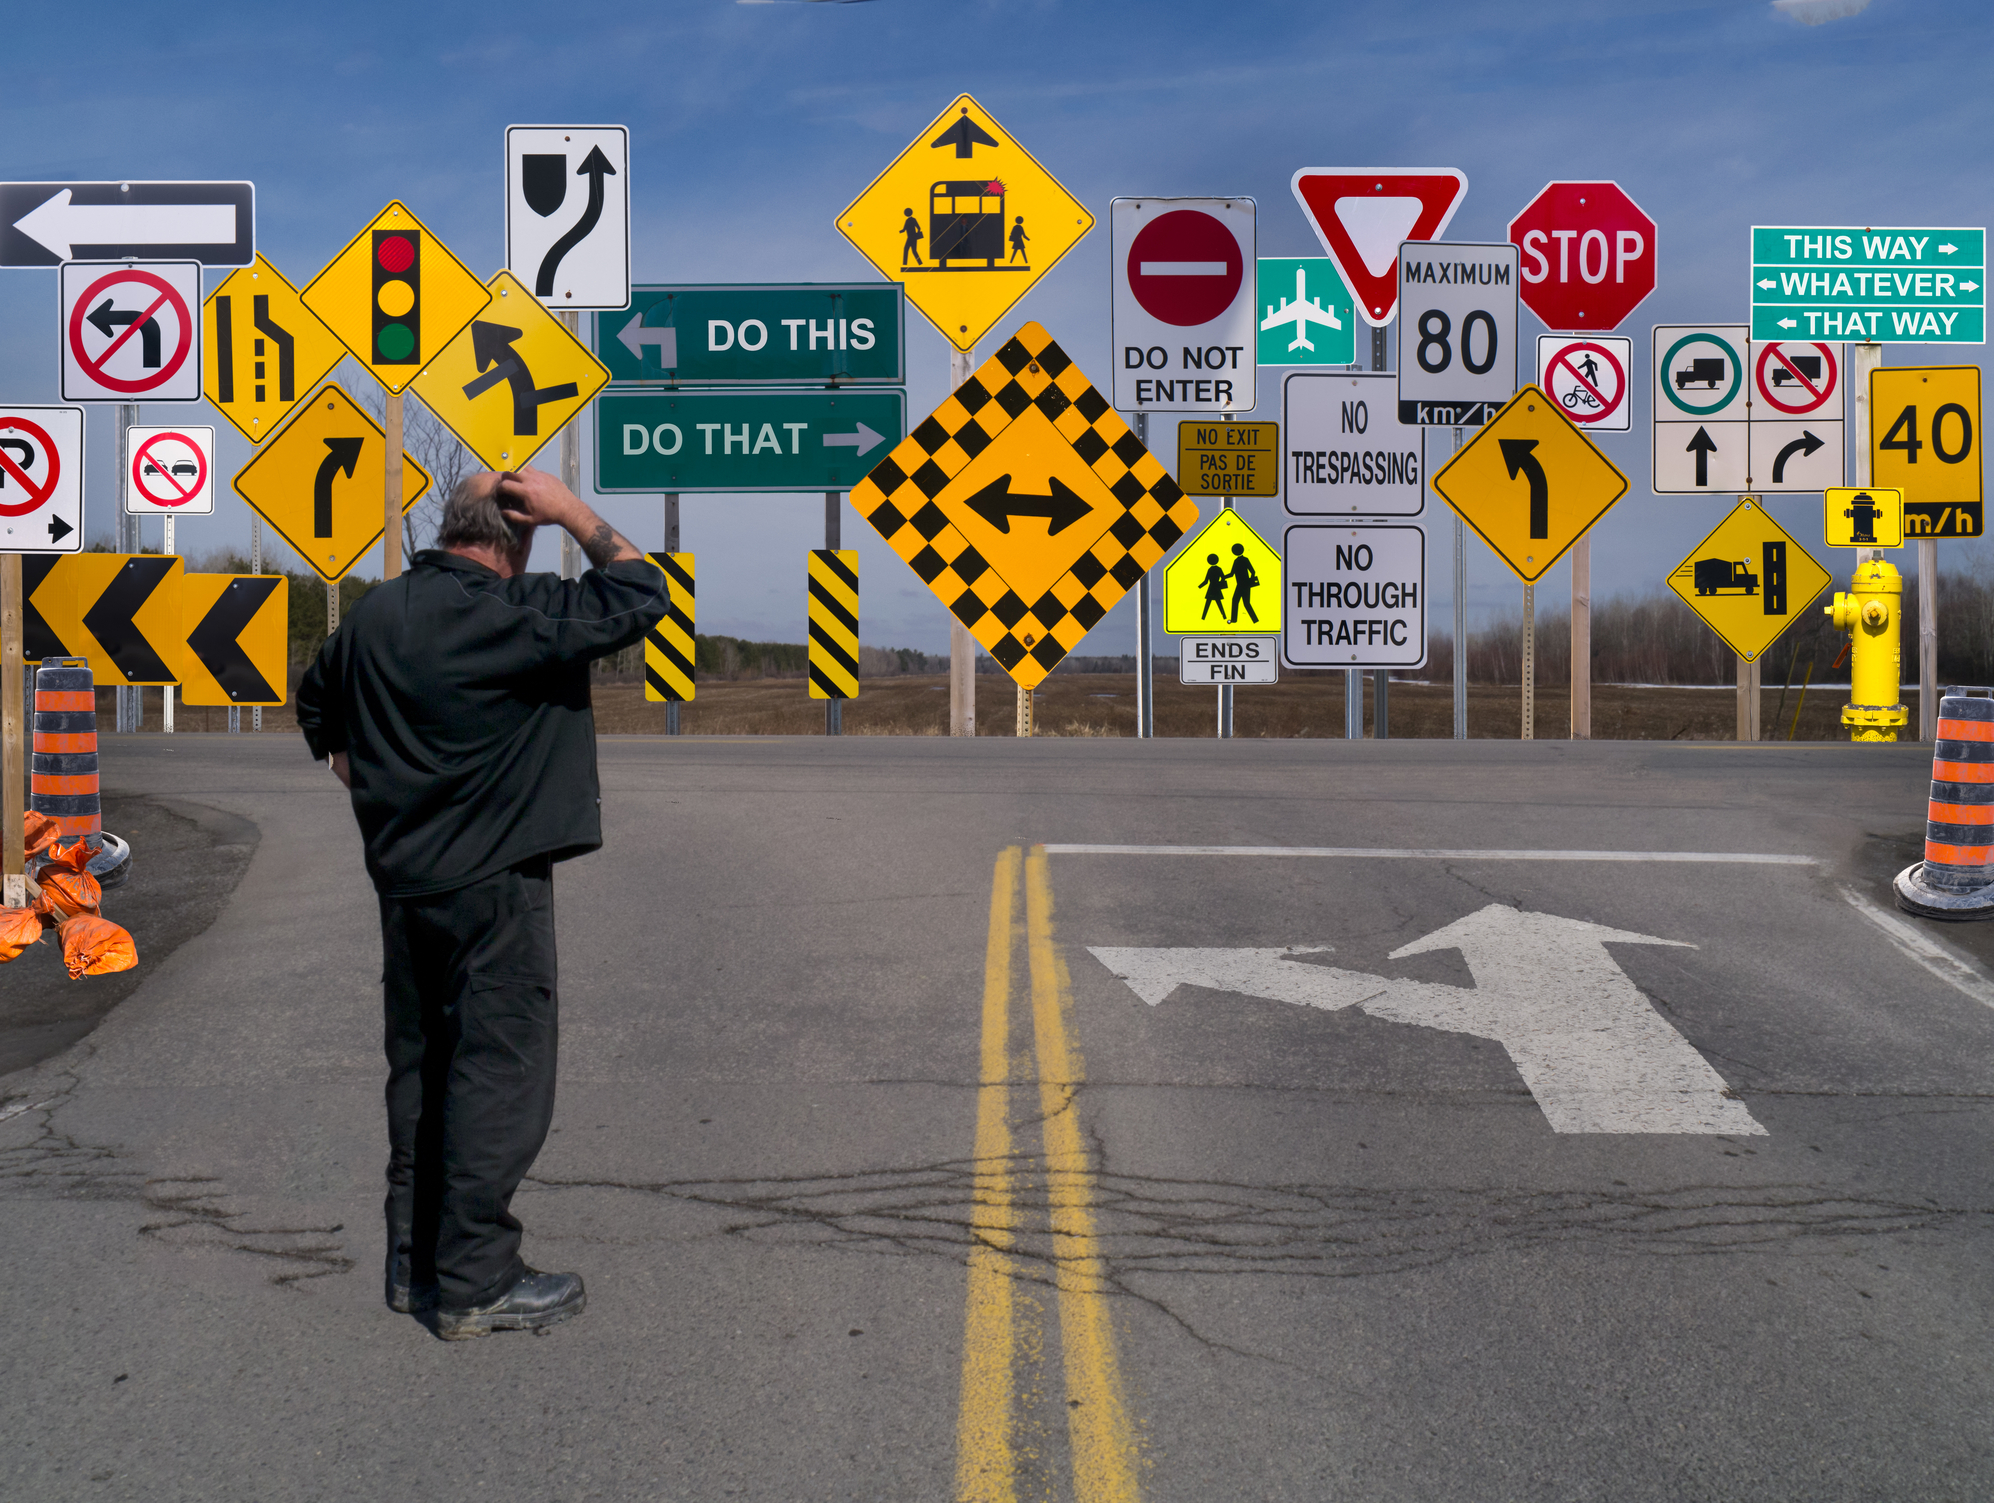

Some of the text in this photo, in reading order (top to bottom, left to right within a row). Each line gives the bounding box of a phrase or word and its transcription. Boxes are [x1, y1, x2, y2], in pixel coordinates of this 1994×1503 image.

[1521, 229, 1644, 284] STOP
[1784, 235, 1930, 260] THIS WAY
[1406, 261, 1510, 286] MAXIMUM
[1780, 272, 1956, 297] WHATEVER
[708, 318, 876, 352] DO THIS
[1803, 311, 1959, 336] THAT WAY
[1416, 308, 1498, 375] 80
[1124, 346, 1244, 370] DO NOT
[1136, 379, 1233, 402] ENTER
[1341, 400, 1369, 435] NO
[1416, 402, 1498, 425] km/h
[623, 423, 808, 456] DO THAT
[1197, 428, 1260, 446] NO EXIT
[1879, 402, 1972, 464] 40
[1200, 454, 1256, 471] PAS DE
[1292, 451, 1418, 485] TRESPASSING
[1201, 474, 1255, 490] SORTIE
[1905, 507, 1973, 534] m/h
[1335, 544, 1373, 571] NO
[1292, 581, 1418, 609] THROUGH
[1301, 619, 1407, 646] TRAFFIC
[1196, 643, 1260, 659] ENDS
[1211, 665, 1246, 680] FIN
